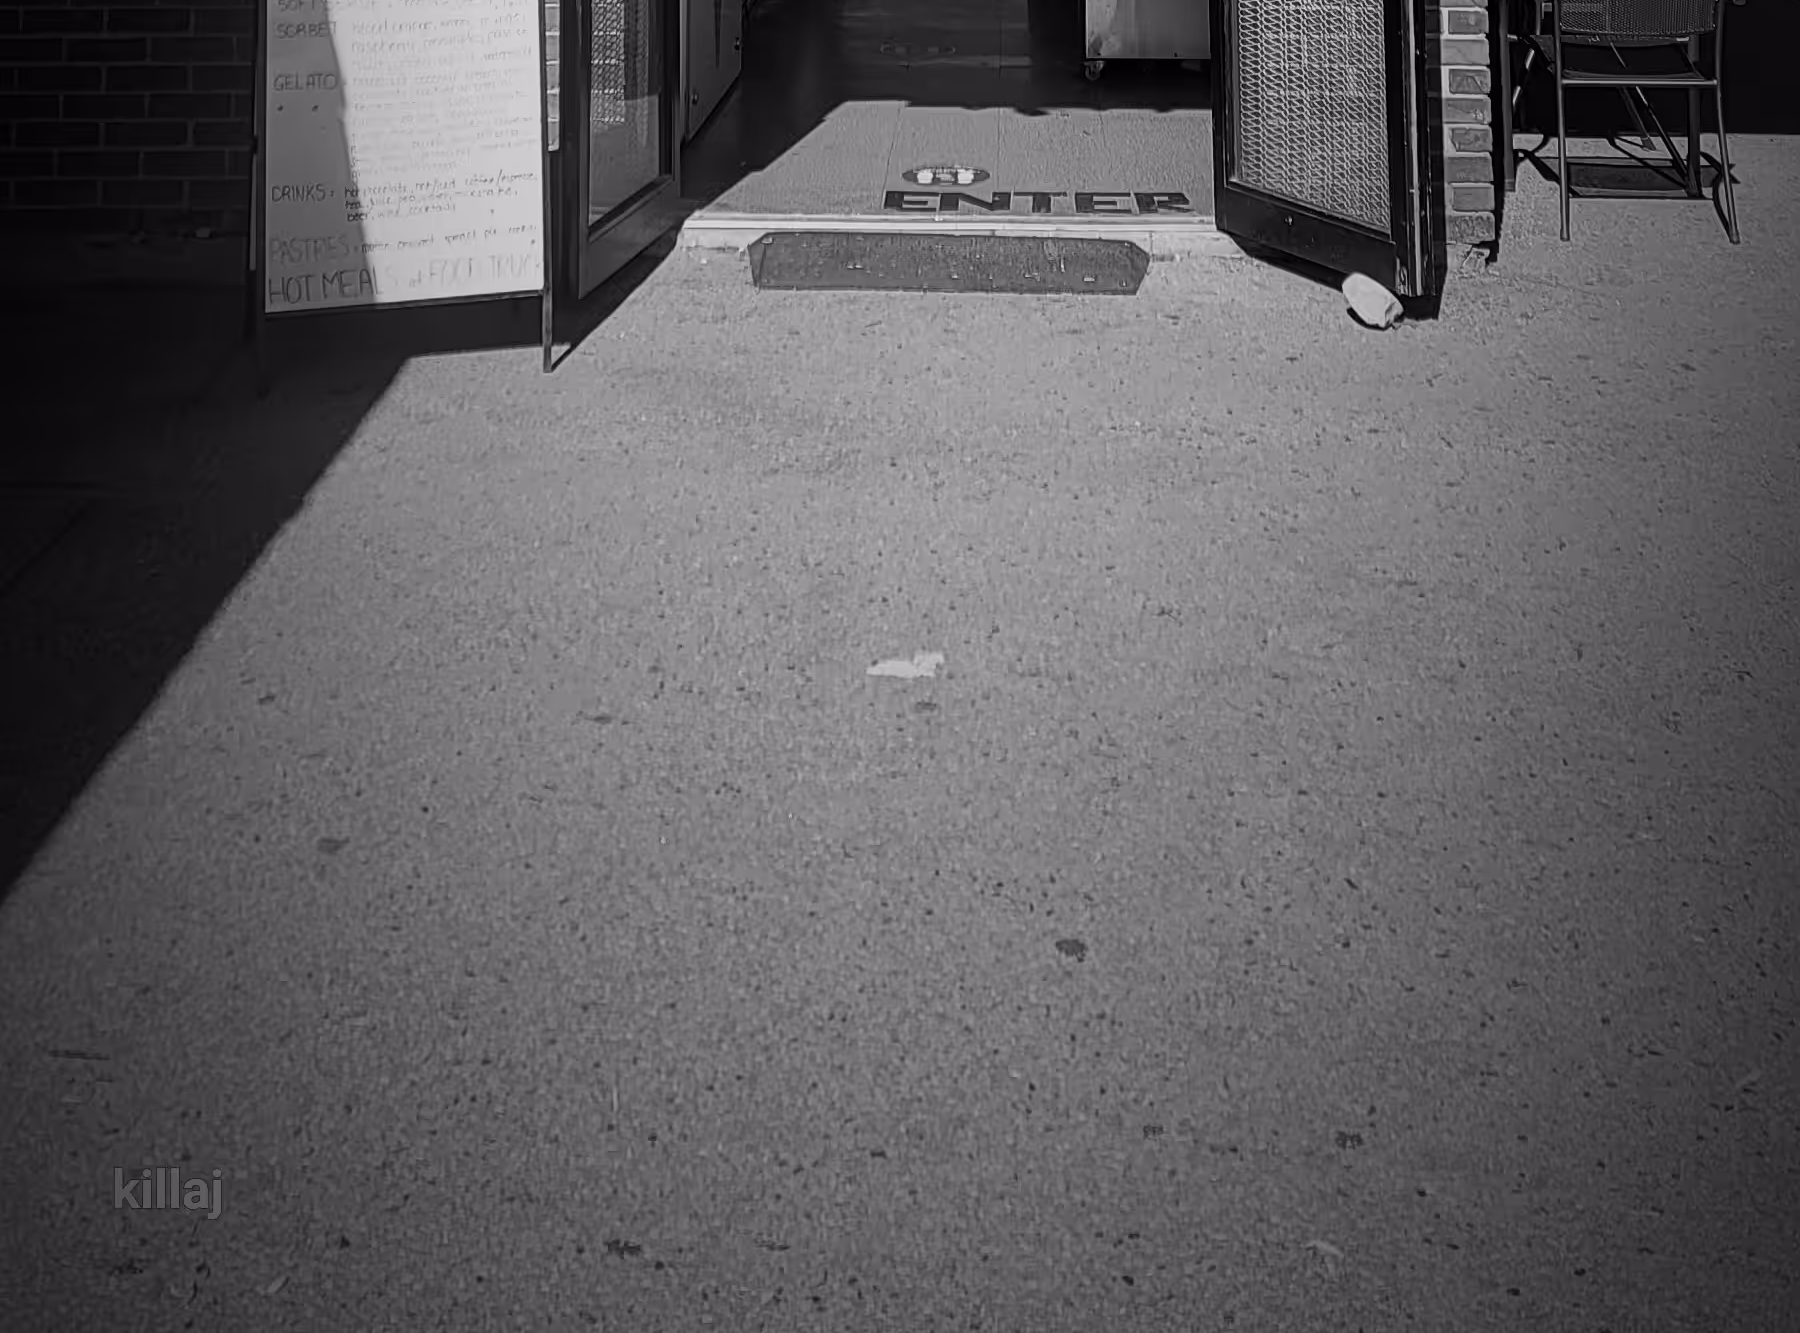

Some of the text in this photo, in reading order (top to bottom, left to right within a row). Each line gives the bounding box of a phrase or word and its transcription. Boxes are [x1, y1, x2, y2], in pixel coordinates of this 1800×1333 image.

[276, 20, 337, 39] SORBET
[273, 72, 339, 91] GELATO
[883, 190, 1197, 215] ENTER
[268, 274, 315, 306] HOT
